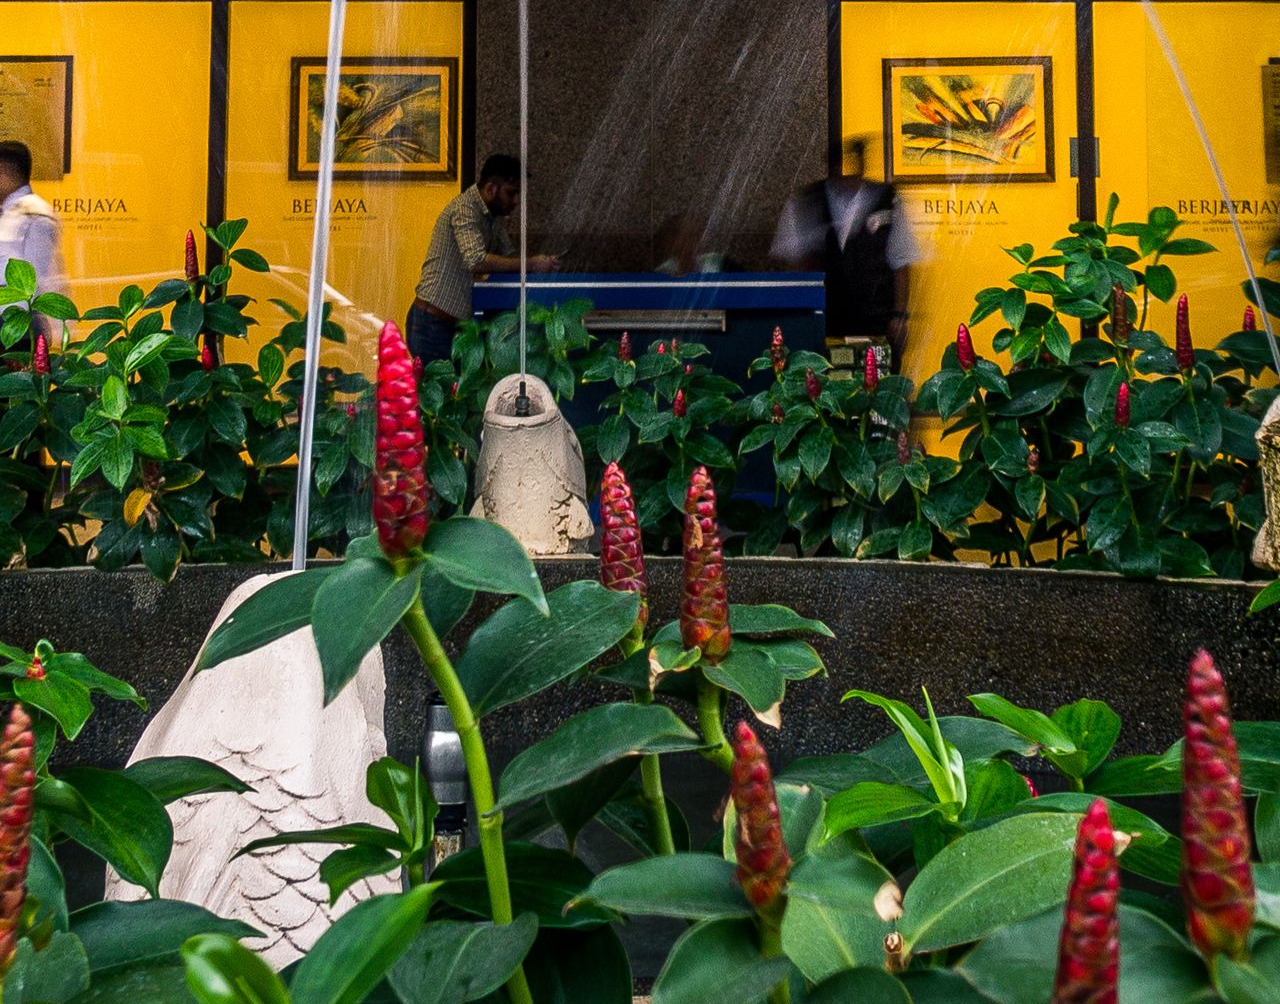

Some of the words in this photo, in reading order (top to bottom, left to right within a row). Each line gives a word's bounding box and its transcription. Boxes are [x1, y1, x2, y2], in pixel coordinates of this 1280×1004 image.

[52, 198, 127, 215] BERJAYA
[292, 198, 367, 214] BEAYA
[924, 199, 999, 216] BERJAYA
